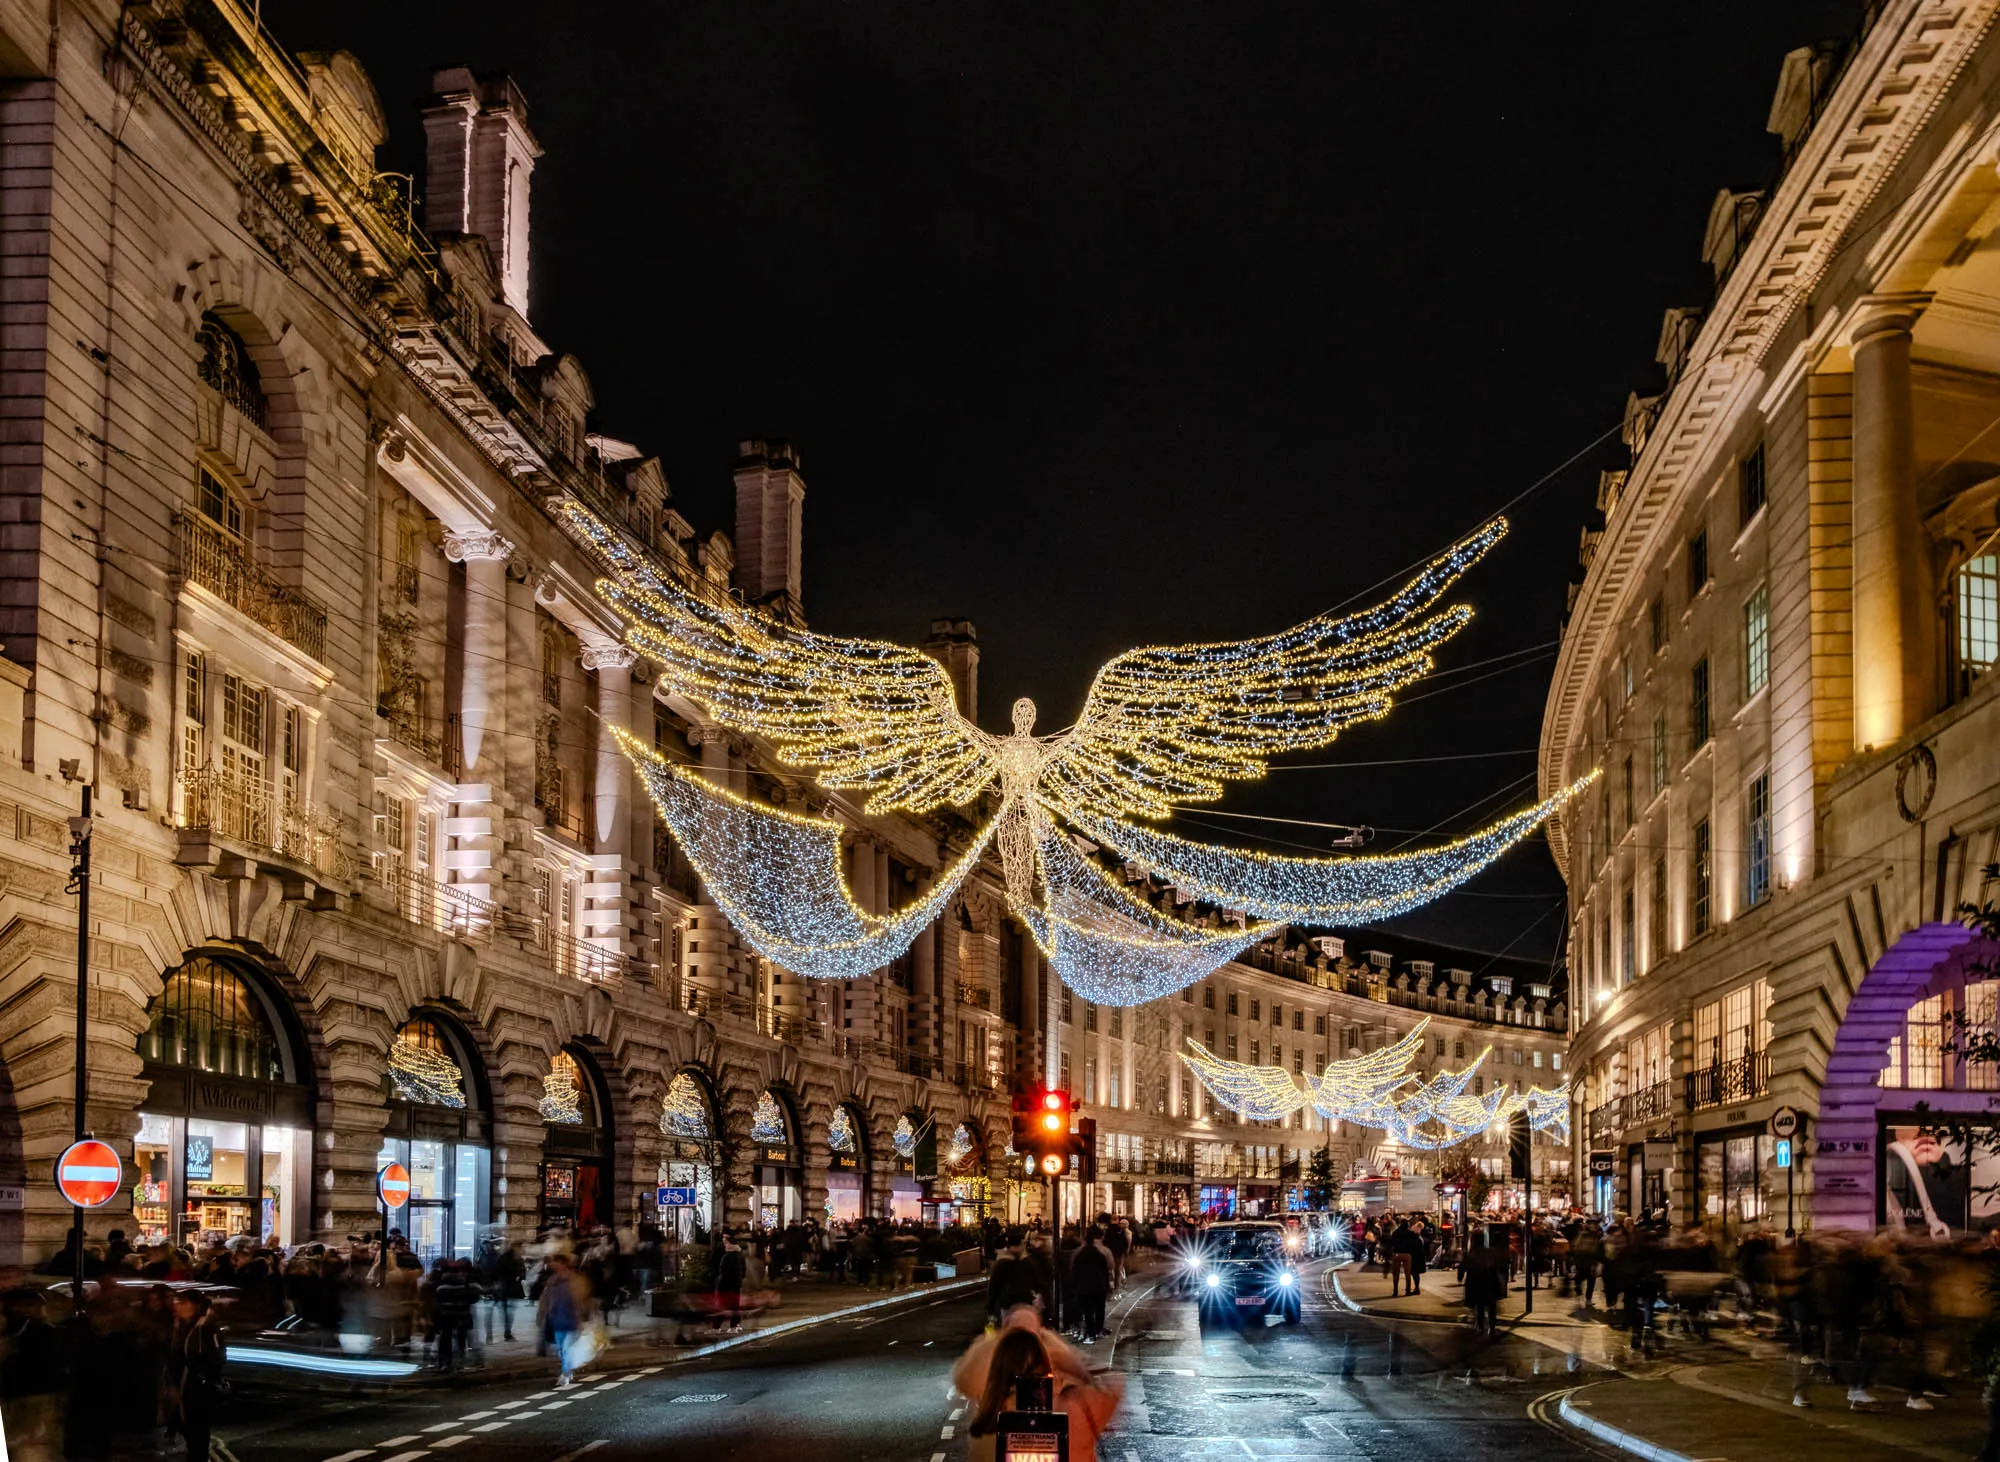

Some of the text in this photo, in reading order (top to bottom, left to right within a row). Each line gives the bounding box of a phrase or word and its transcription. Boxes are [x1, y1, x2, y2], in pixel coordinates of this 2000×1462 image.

[768, 1149, 786, 1161] Barbour
[1591, 1161, 1611, 1172] UGG
[1010, 1453, 1056, 1462] WAIT
